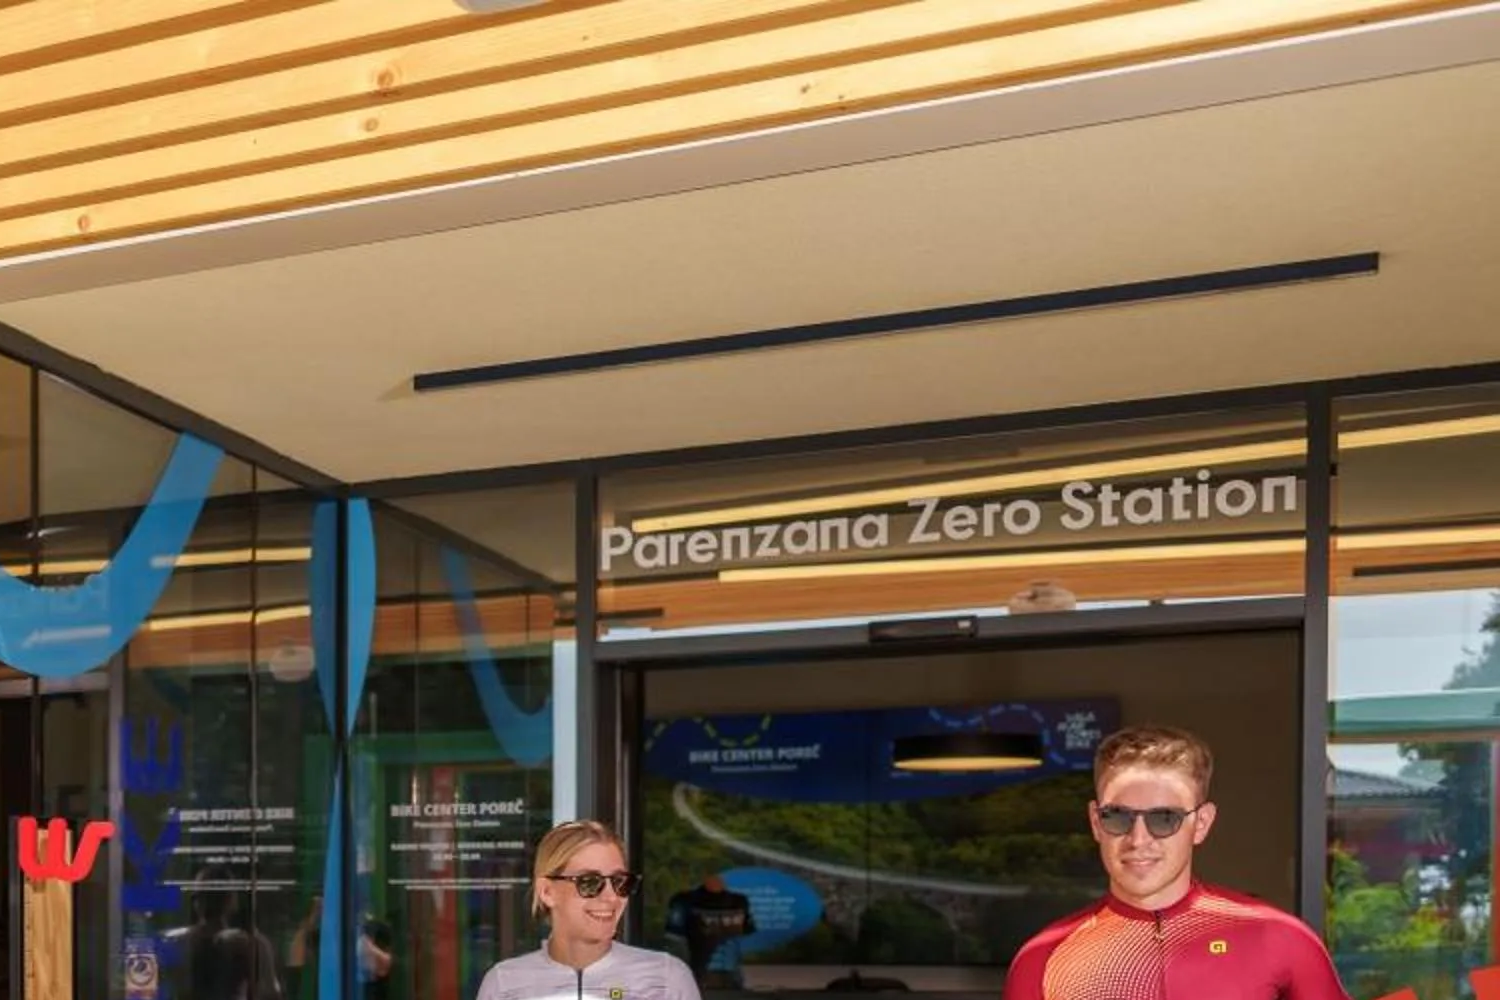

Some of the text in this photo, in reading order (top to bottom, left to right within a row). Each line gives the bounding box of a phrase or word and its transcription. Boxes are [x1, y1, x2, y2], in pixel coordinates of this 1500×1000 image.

[600, 470, 1298, 572] Parenzana Zero Station
[390, 804, 421, 817] BIKE
[423, 803, 477, 816] CENTER
